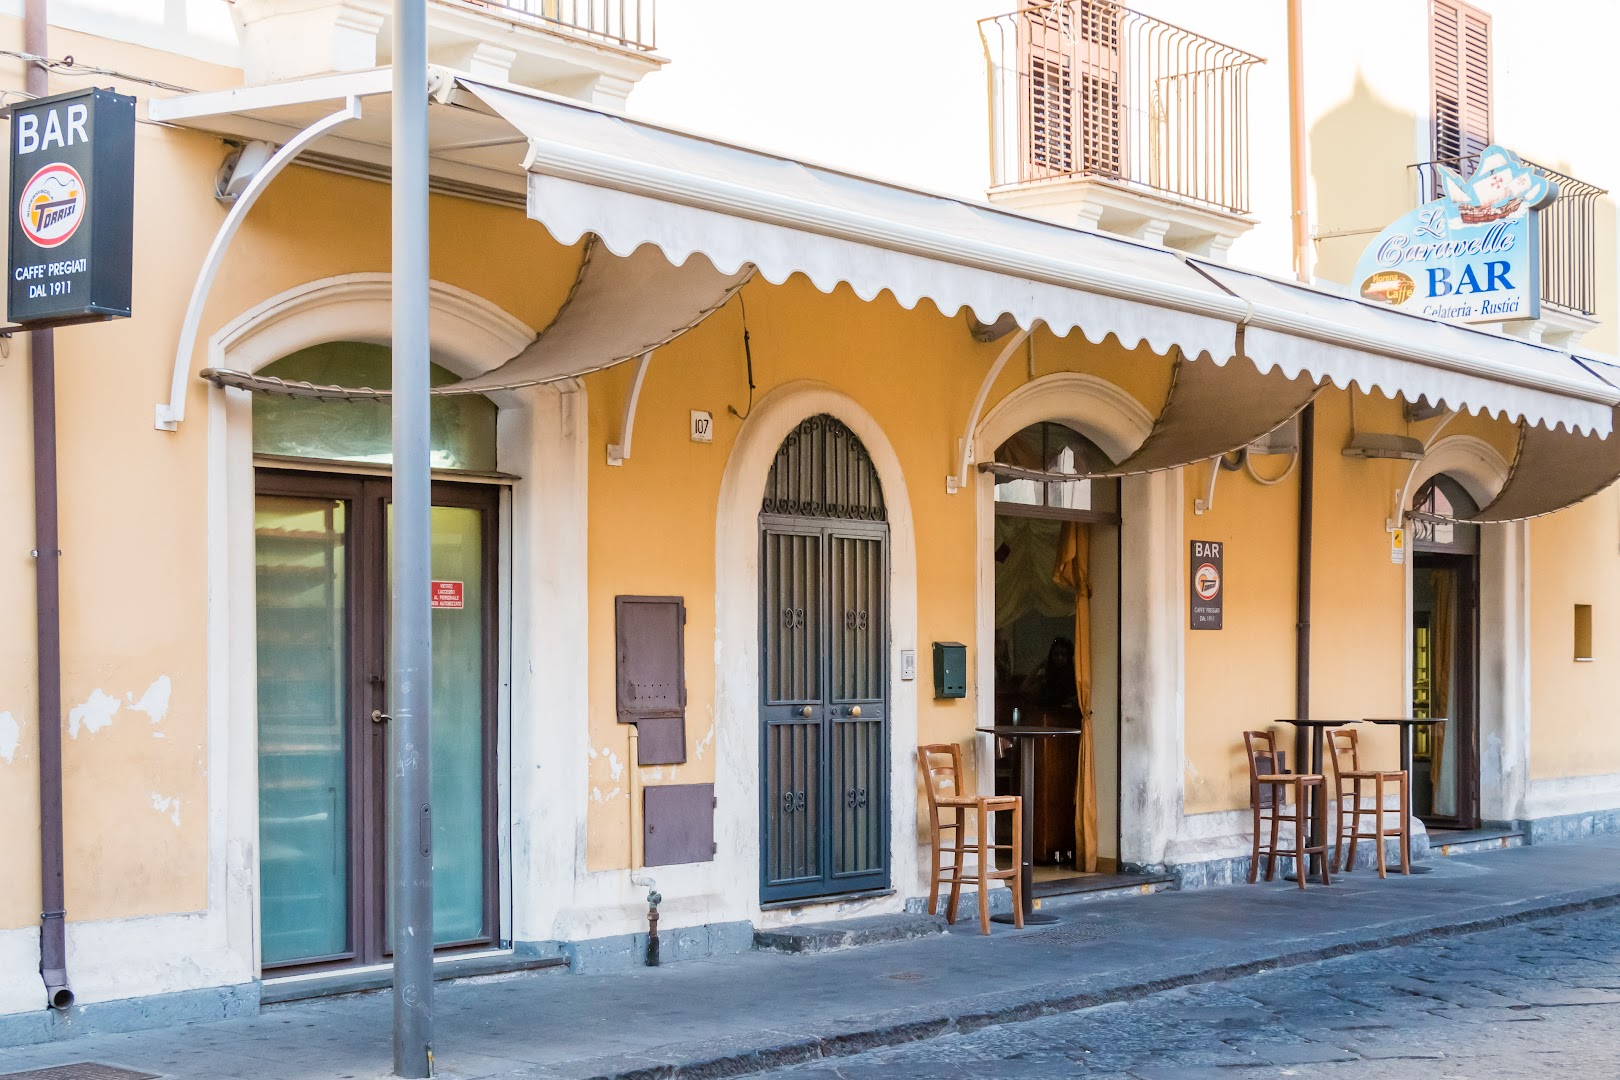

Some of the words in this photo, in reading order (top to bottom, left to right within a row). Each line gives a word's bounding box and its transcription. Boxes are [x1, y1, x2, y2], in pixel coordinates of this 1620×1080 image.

[18, 103, 89, 155] BAR
[1413, 206, 1447, 239] Le
[1377, 220, 1518, 267] Caravelle
[15, 265, 46, 281] CAFFE'
[48, 259, 87, 277] PREGIATI
[1372, 273, 1398, 283] Morena
[1425, 261, 1516, 298] BAR
[29, 285, 47, 299] DAL
[49, 281, 71, 296] 1911
[1481, 297, 1520, 316] Rustici
[695, 418, 709, 434] 107
[1195, 543, 1219, 558] BAR
